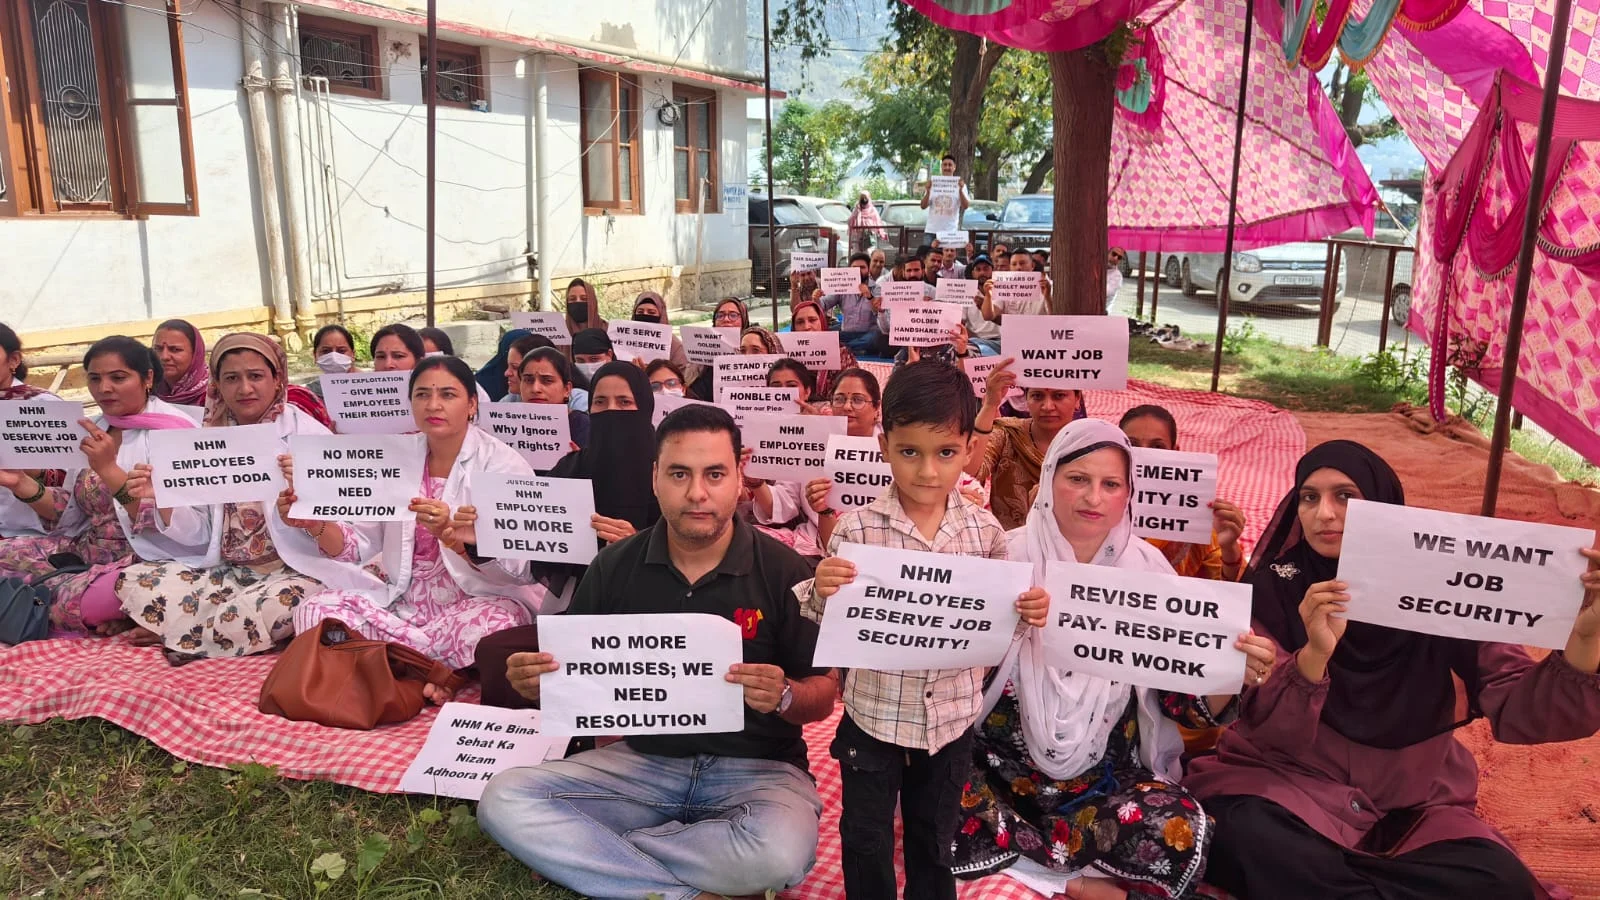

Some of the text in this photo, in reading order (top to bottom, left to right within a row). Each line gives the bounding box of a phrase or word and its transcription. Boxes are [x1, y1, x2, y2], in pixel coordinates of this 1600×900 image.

[616, 326, 662, 338] WE SERVE
[1050, 329, 1075, 341] WE
[626, 340, 667, 351] DESERVE
[1021, 349, 1104, 360] WANT JOB
[351, 376, 404, 384] EXPLOITATION
[1023, 368, 1102, 380] SECURITY
[350, 387, 373, 396] GIVE
[376, 386, 398, 395] NHM
[730, 392, 791, 401] HONBLE CM
[343, 398, 401, 408] EMPLOYEES
[19, 406, 45, 415] NHM
[339, 409, 409, 420] THEIR RIGHTS!
[489, 411, 503, 419] We
[505, 412, 527, 420] Save
[529, 413, 552, 421] Lives
[6, 420, 68, 428] EMPLOYEES
[493, 424, 558, 436] Why Ignore
[779, 426, 805, 435] NHM
[2, 433, 78, 441] DESERVE JOB
[194, 439, 227, 451] NHM
[518, 441, 560, 452] Rights?
[759, 440, 825, 452] EMPLOYEES
[323, 449, 384, 459] NO MORE
[172, 455, 255, 470] EMPLOYEES
[751, 455, 802, 466] DISTRICT
[307, 468, 400, 480] PROMISES; WE
[163, 472, 271, 489] DISTRICT DODA
[505, 479, 534, 487] JUSTICE
[338, 487, 372, 497] NEED
[515, 490, 543, 499] NHM
[1179, 494, 1199, 508] IS
[312, 505, 396, 516] RESOLUTION
[496, 502, 567, 514] EMPLOYEES
[494, 518, 573, 534] NO MORE
[503, 538, 569, 554] DELAYS
[1413, 532, 1554, 567] WE WANT
[900, 564, 952, 585] NHM
[1446, 572, 1504, 592] JOB
[864, 585, 986, 611] EMPLOYEES
[1070, 583, 1219, 619] REVISE OUR
[1397, 596, 1544, 628] SECURITY
[846, 606, 992, 632] DESERVE JOB
[1058, 612, 1228, 650] PAY- RESPECT
[591, 635, 687, 649] NO MORE
[857, 628, 970, 651] SECURITY!
[1073, 645, 1206, 678] OUR WORK
[566, 661, 714, 679] PROMISES; WE
[613, 688, 668, 702] NEED
[450, 718, 540, 735] NHM Ke Bina-
[575, 713, 707, 729] RESOLUTION
[456, 736, 515, 750] Sehat Ka
[455, 753, 496, 765] Nizam
[423, 766, 478, 780] Adhoora
